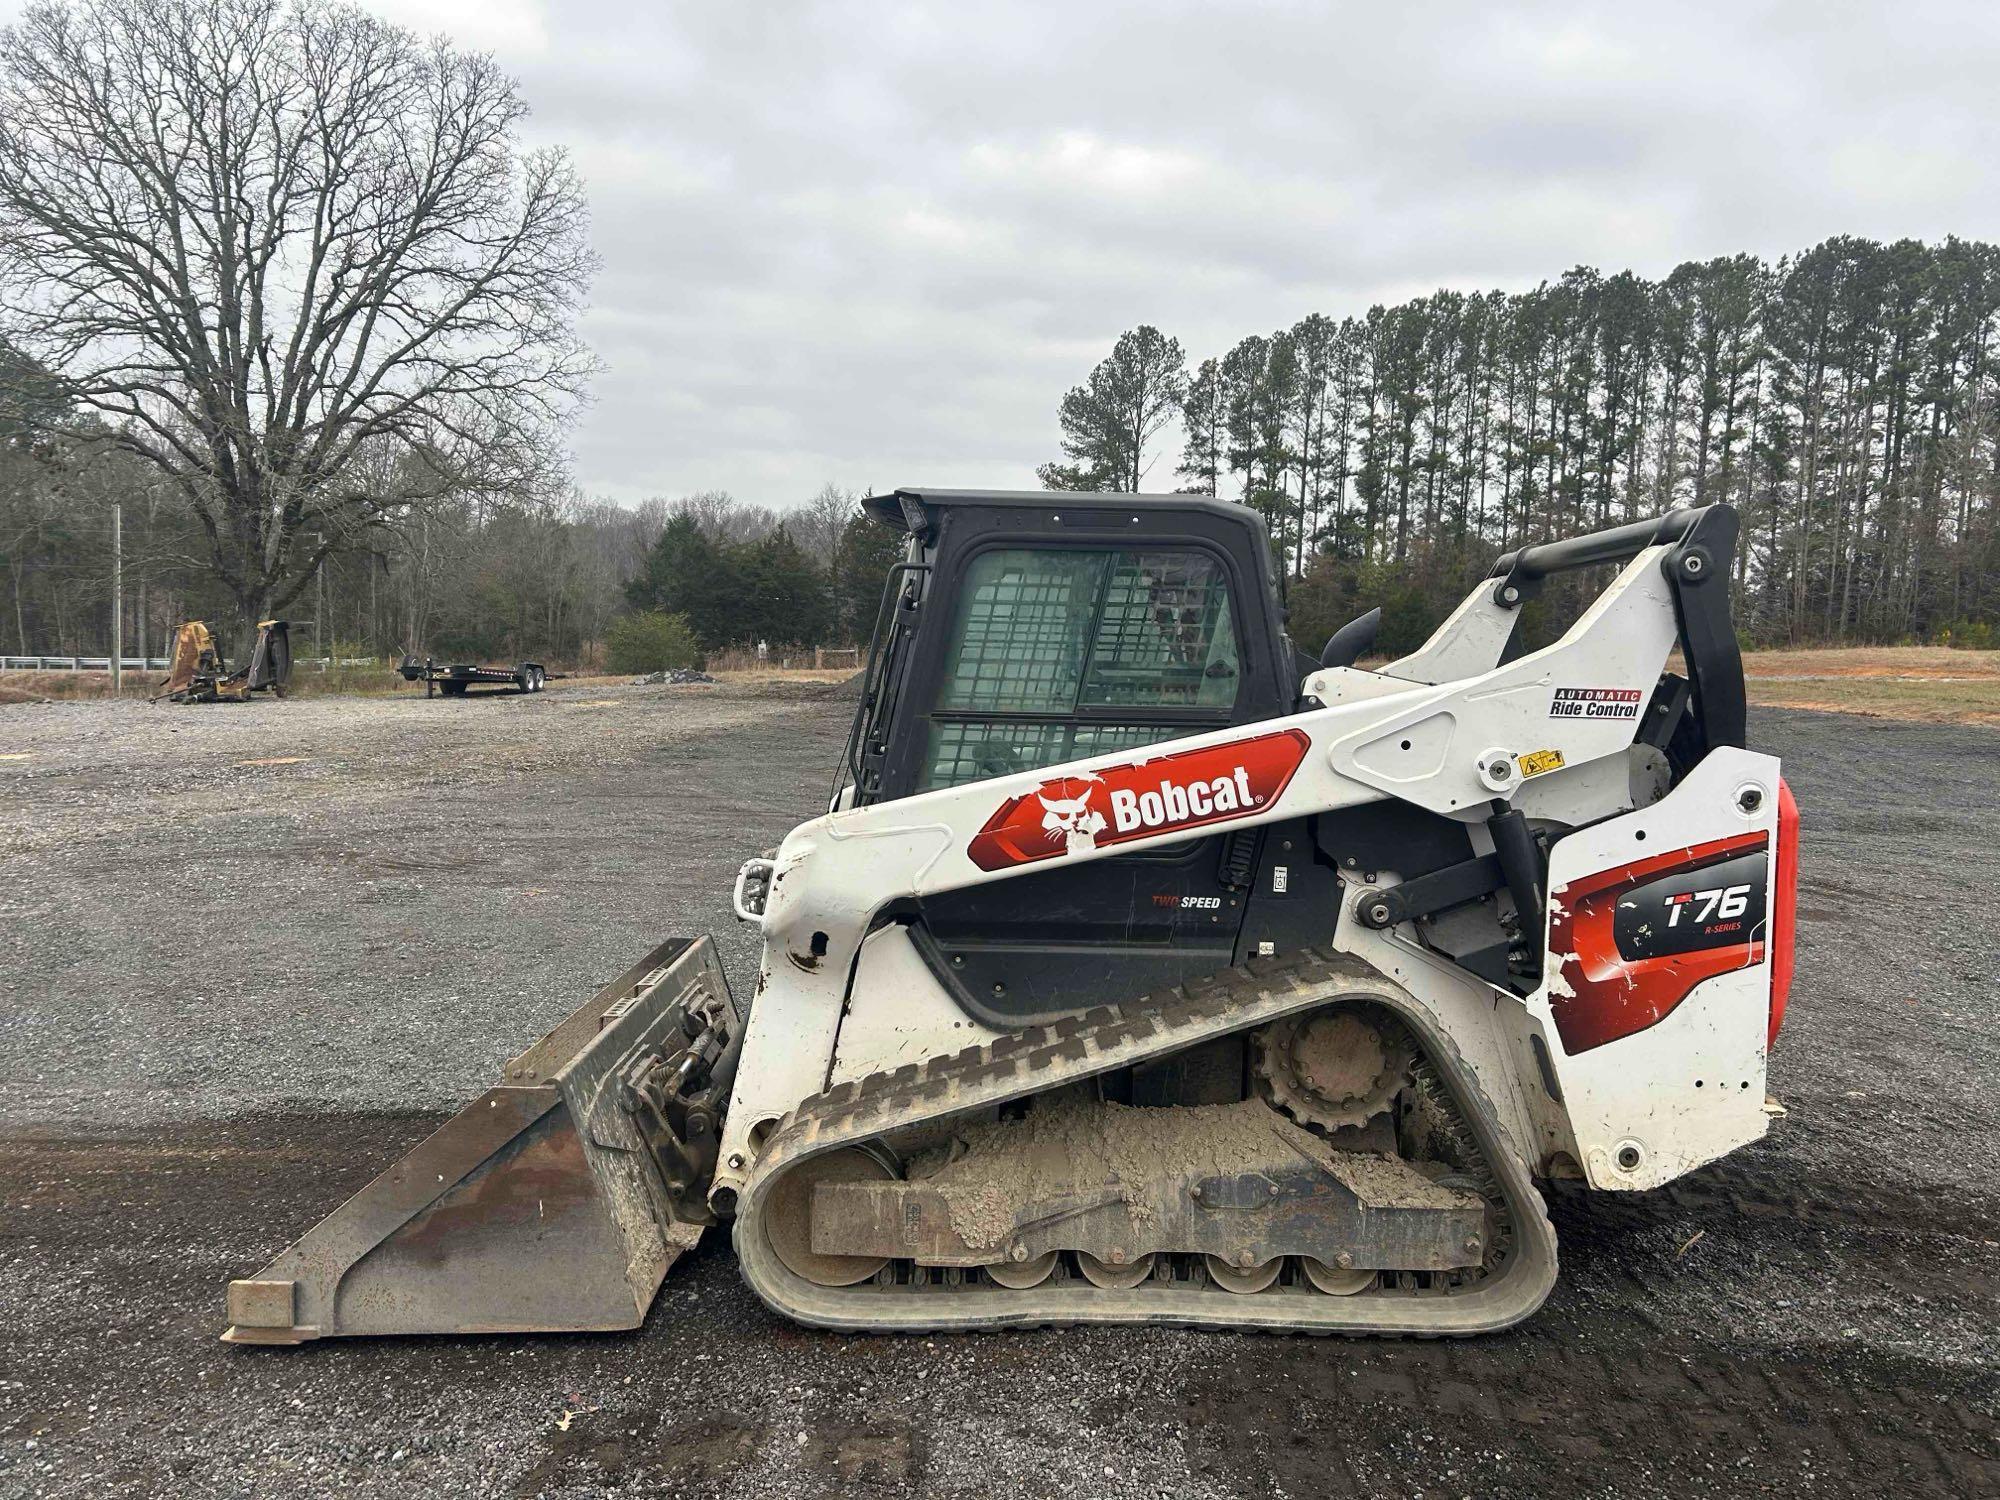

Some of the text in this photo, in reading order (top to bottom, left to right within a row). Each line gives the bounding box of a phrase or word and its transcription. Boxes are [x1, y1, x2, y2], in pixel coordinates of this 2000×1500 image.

[1557, 690, 1638, 701] AUTOMATIC
[1550, 701, 1639, 717] Ride Control
[1110, 766, 1254, 832] Bobcat
[1180, 896, 1221, 909] SPEED
[1664, 884, 1751, 928] T76
[1704, 921, 1742, 935] R-SERIES
